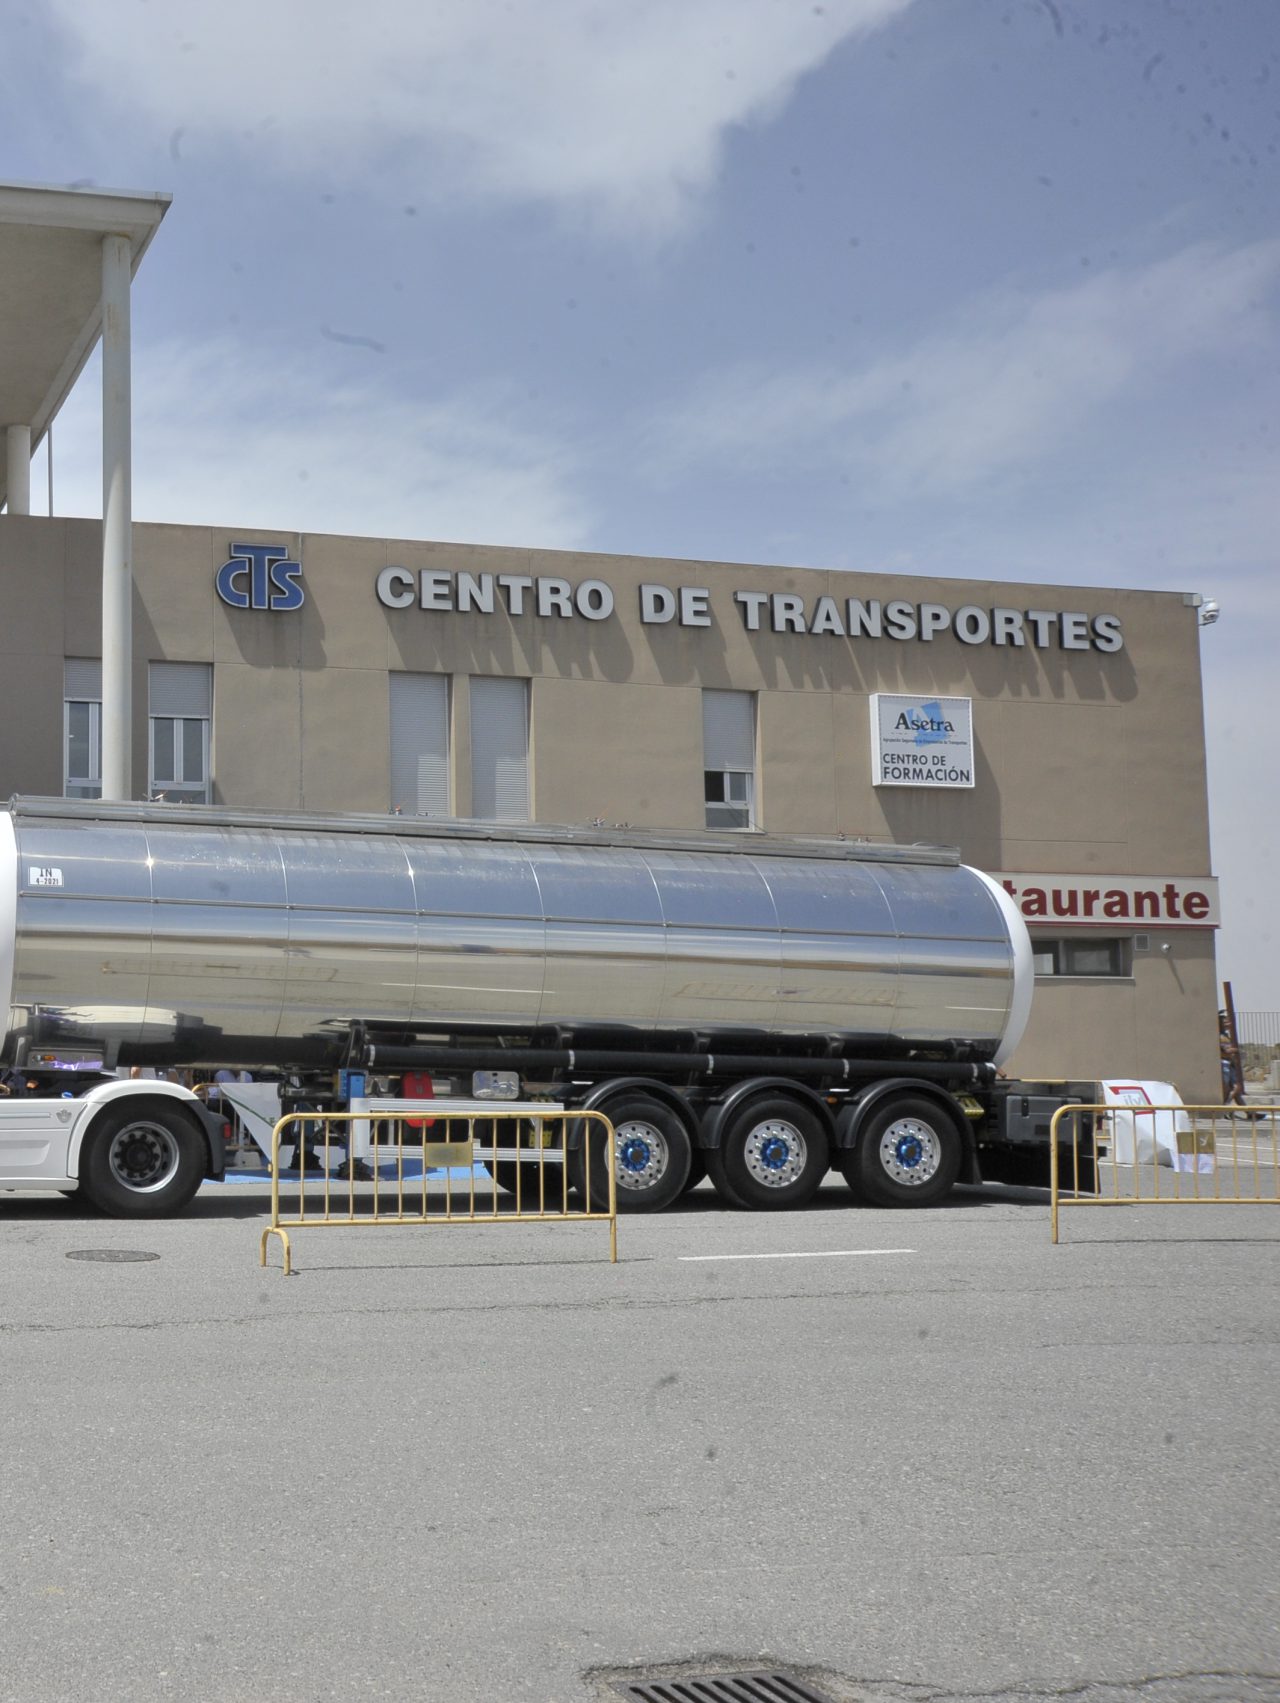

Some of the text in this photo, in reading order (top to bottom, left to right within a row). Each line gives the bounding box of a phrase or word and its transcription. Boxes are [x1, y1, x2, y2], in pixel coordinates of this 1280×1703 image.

[215, 542, 305, 611] CTS
[375, 565, 1124, 653] CENTRO DE TRANSPORTES
[894, 712, 955, 732] Asetra
[882, 753, 946, 766] CENTRO DE
[883, 766, 970, 782] FORMACIÓN
